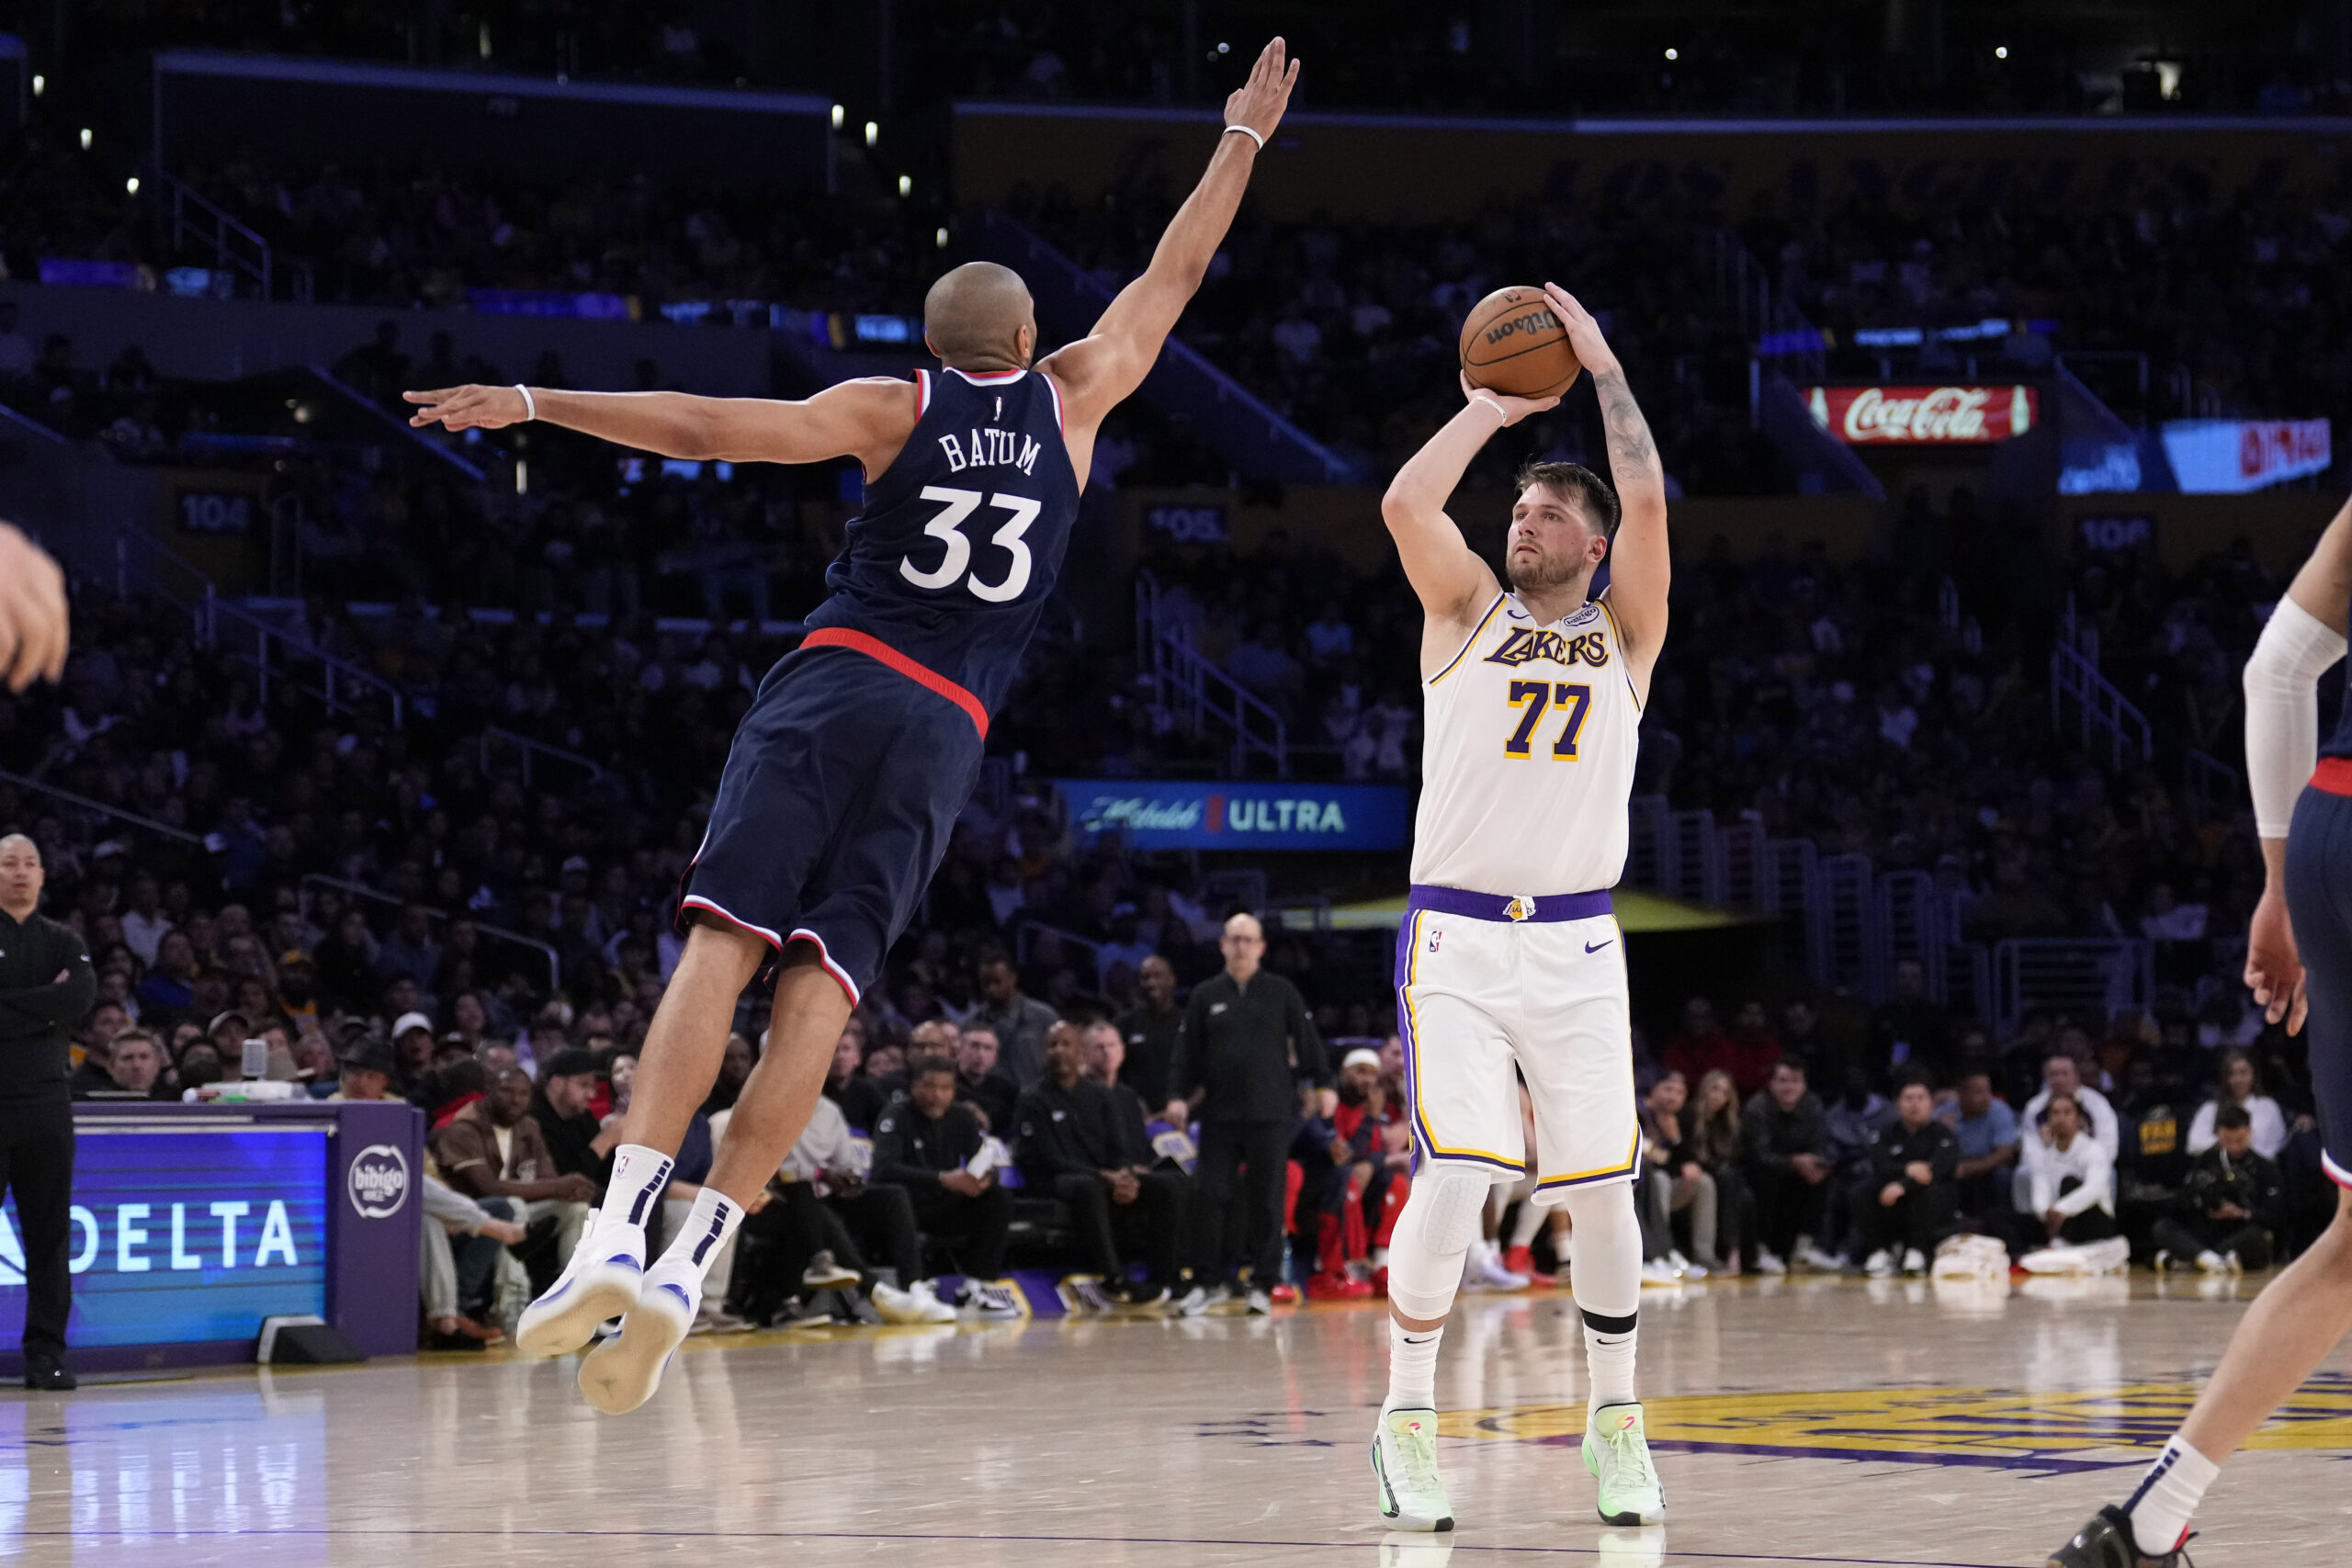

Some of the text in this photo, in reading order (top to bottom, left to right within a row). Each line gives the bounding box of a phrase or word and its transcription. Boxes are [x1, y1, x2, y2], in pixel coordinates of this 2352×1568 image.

[1844, 387, 1992, 441] Coca-Cola
[938, 428, 1041, 476] BATUM
[899, 485, 1041, 603] 33
[1482, 626, 1611, 669] LAKERS
[1504, 679, 1592, 762] 77
[1229, 800, 1345, 833] ULTRA
[356, 1163, 403, 1197] bibigo
